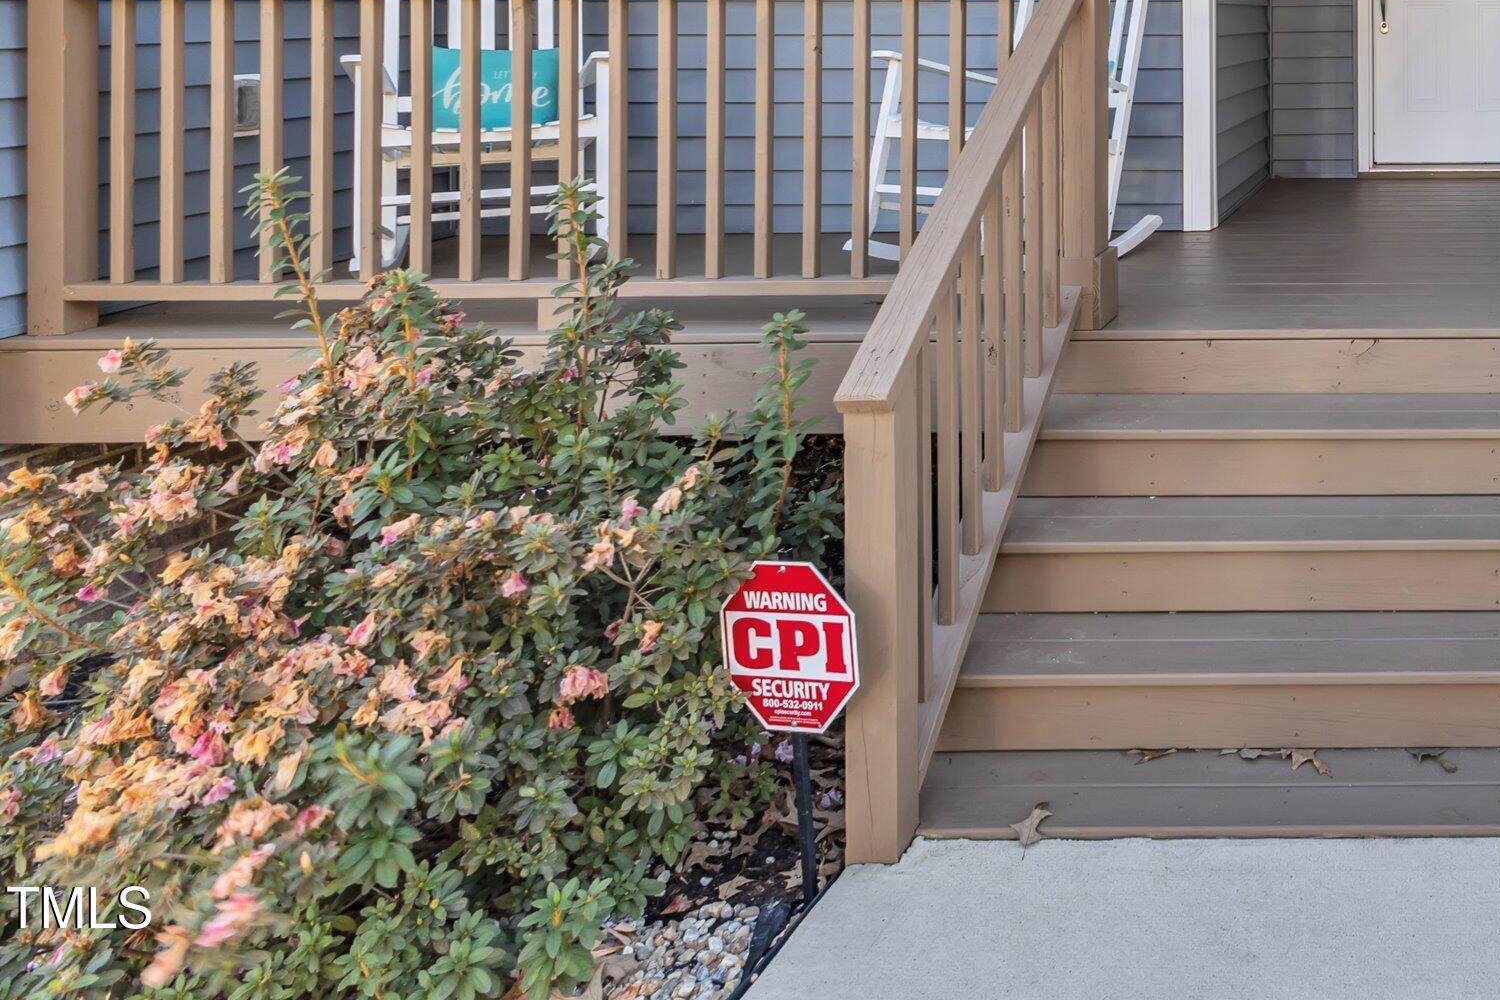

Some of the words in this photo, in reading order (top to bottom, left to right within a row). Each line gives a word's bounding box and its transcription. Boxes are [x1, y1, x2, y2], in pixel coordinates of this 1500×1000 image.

[743, 590, 827, 611] WARNING
[732, 617, 847, 674] CPI
[751, 678, 830, 701] SECURITY
[762, 698, 823, 711] 800-532-0911
